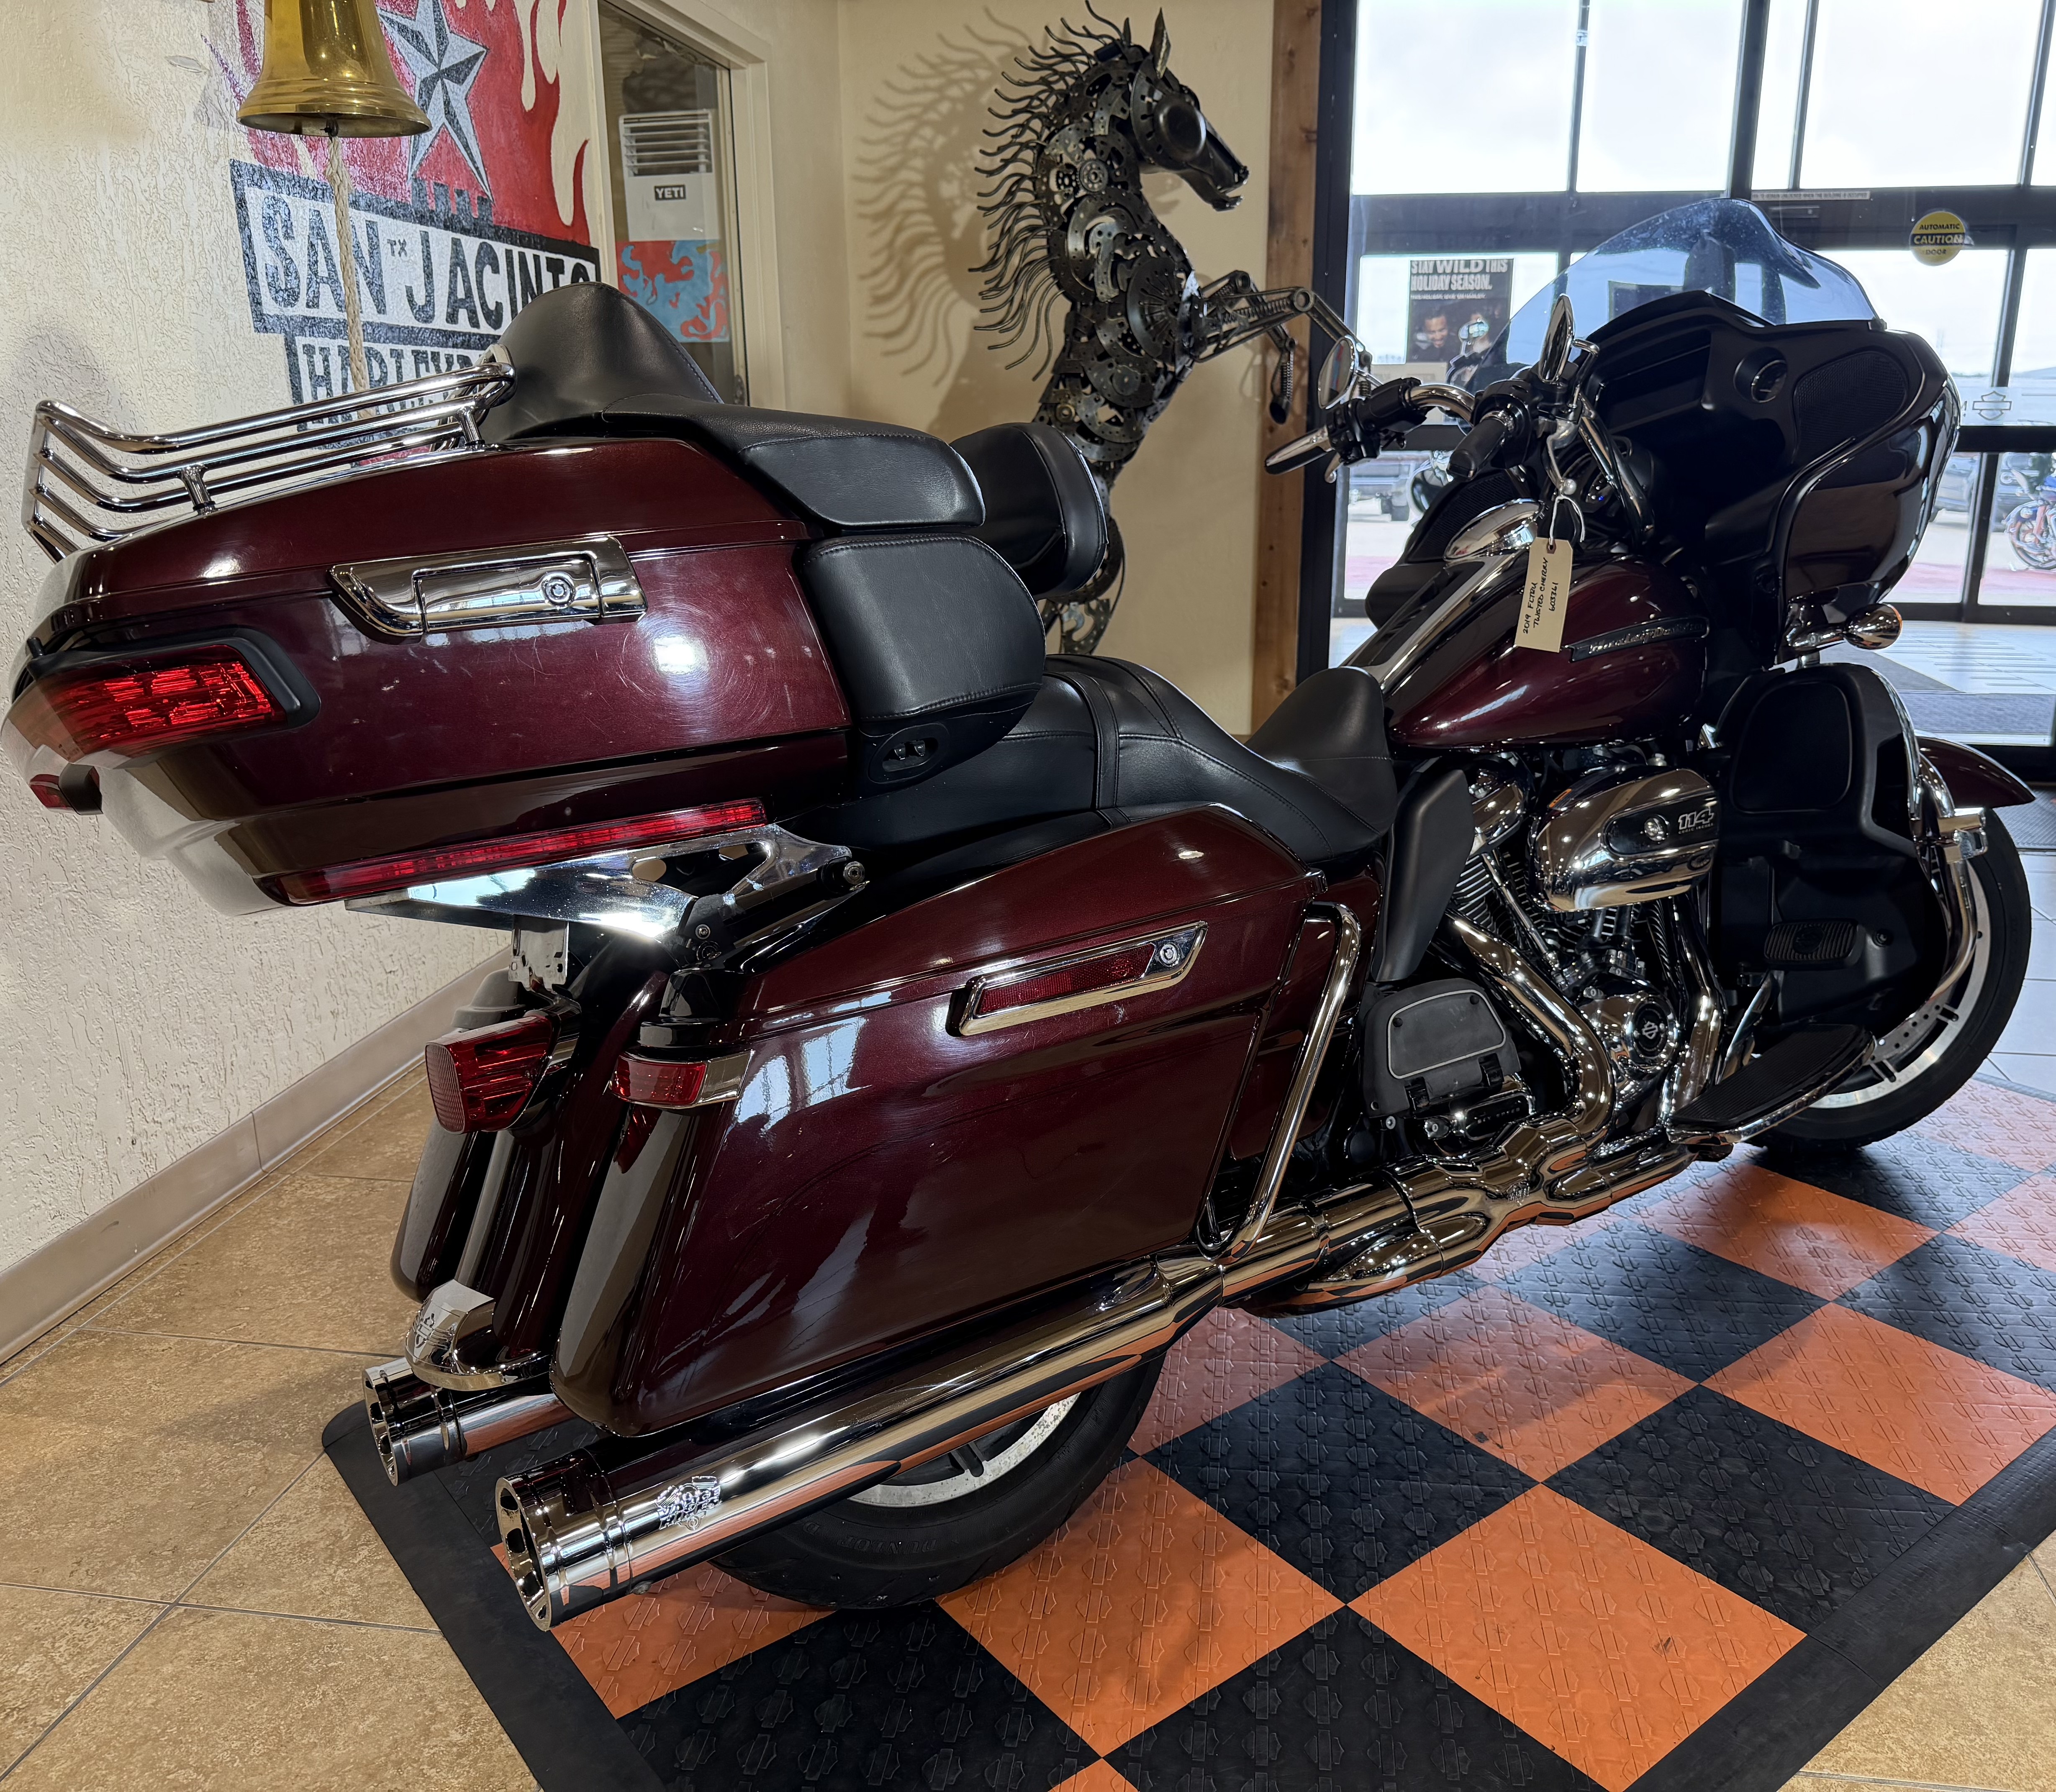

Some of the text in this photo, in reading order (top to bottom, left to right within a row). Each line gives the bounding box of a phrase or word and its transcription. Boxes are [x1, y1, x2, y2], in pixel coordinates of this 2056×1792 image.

[656, 187, 684, 199] YETI
[1914, 234, 1963, 244] CAUTION
[262, 195, 387, 315] SAN
[388, 238, 408, 257] TX
[1411, 259, 1508, 274] STAY WILD THIS
[1411, 274, 1451, 291] HOLIDAY
[1533, 557, 1548, 628] TWISTED CHERRY
[1548, 582, 1559, 612] 603361
[1523, 614, 1531, 634] 2019
[1678, 809, 1714, 830] 114
